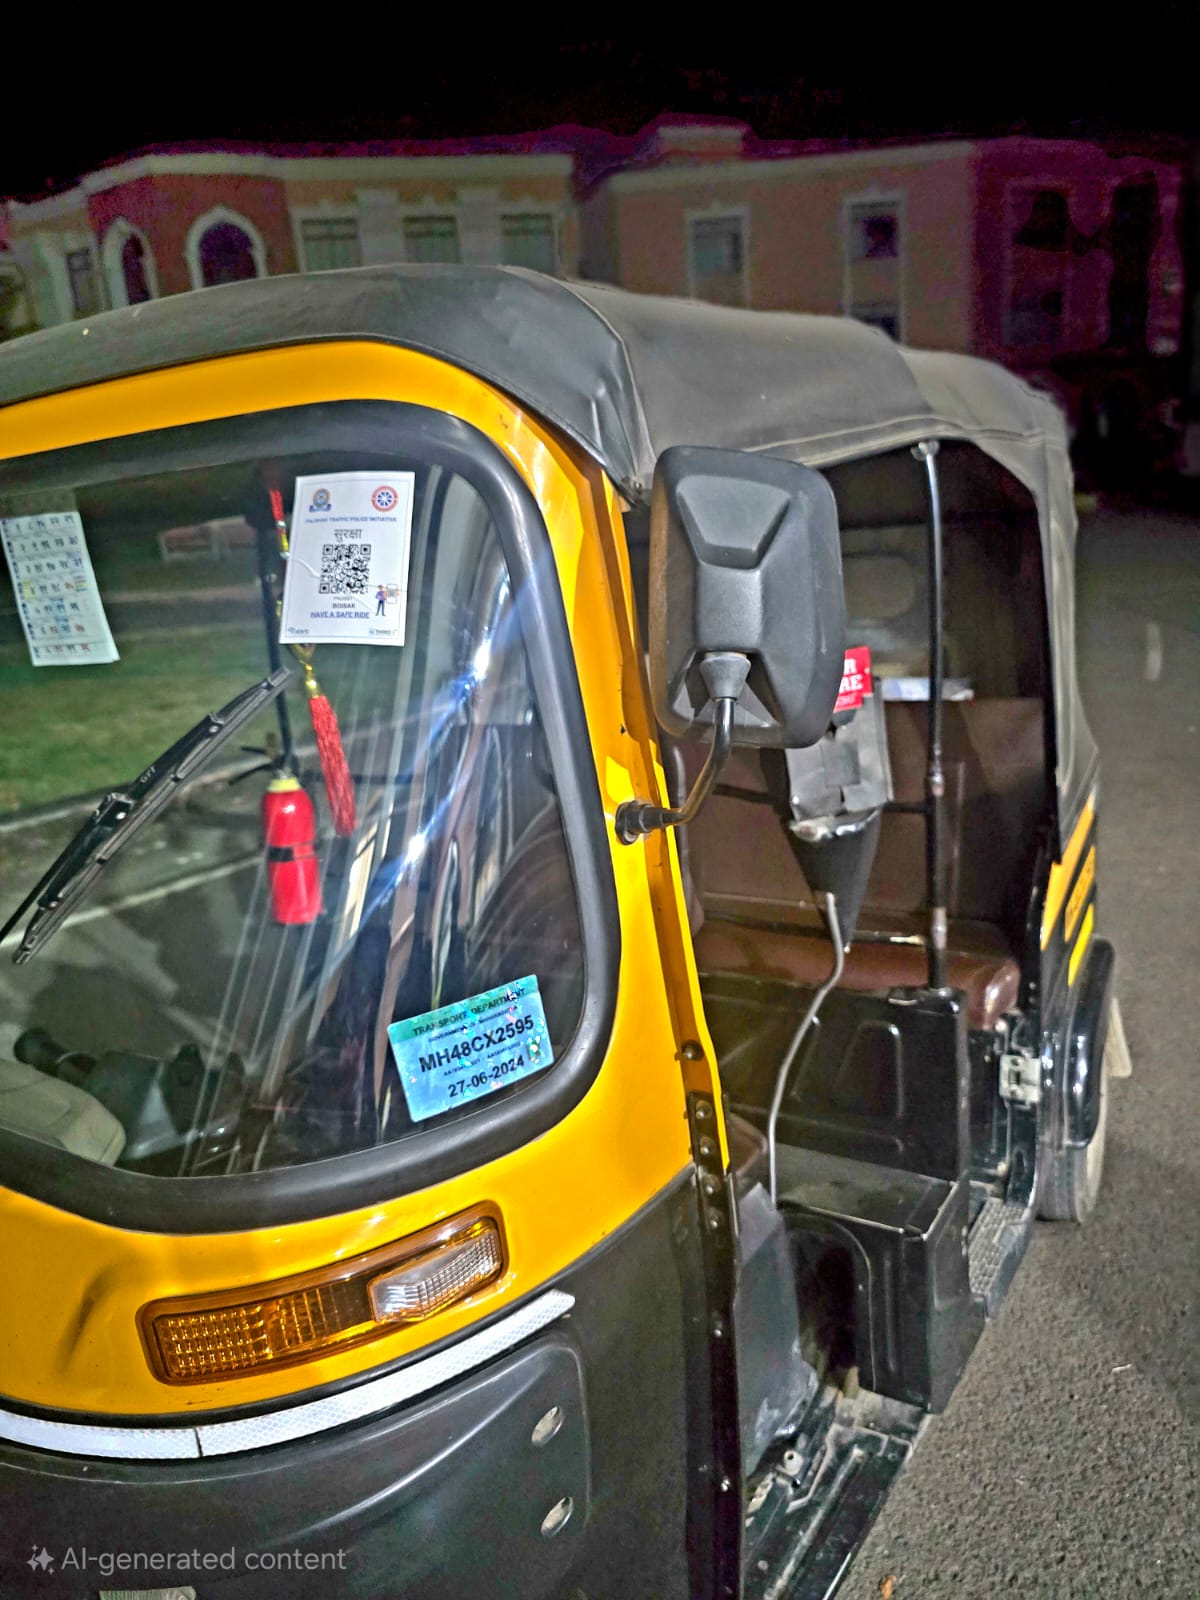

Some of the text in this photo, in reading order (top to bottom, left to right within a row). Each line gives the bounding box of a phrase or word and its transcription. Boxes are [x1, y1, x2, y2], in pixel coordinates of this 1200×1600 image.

[334, 528, 362, 542] सुरक्षा
[310, 611, 328, 619] HAVE
[336, 611, 353, 619] SAFE
[354, 611, 370, 619] RIDE
[413, 1010, 468, 1036] TRANSPORT
[419, 1015, 534, 1073] MH48CX2595
[448, 1055, 525, 1098] 27-06-2024
